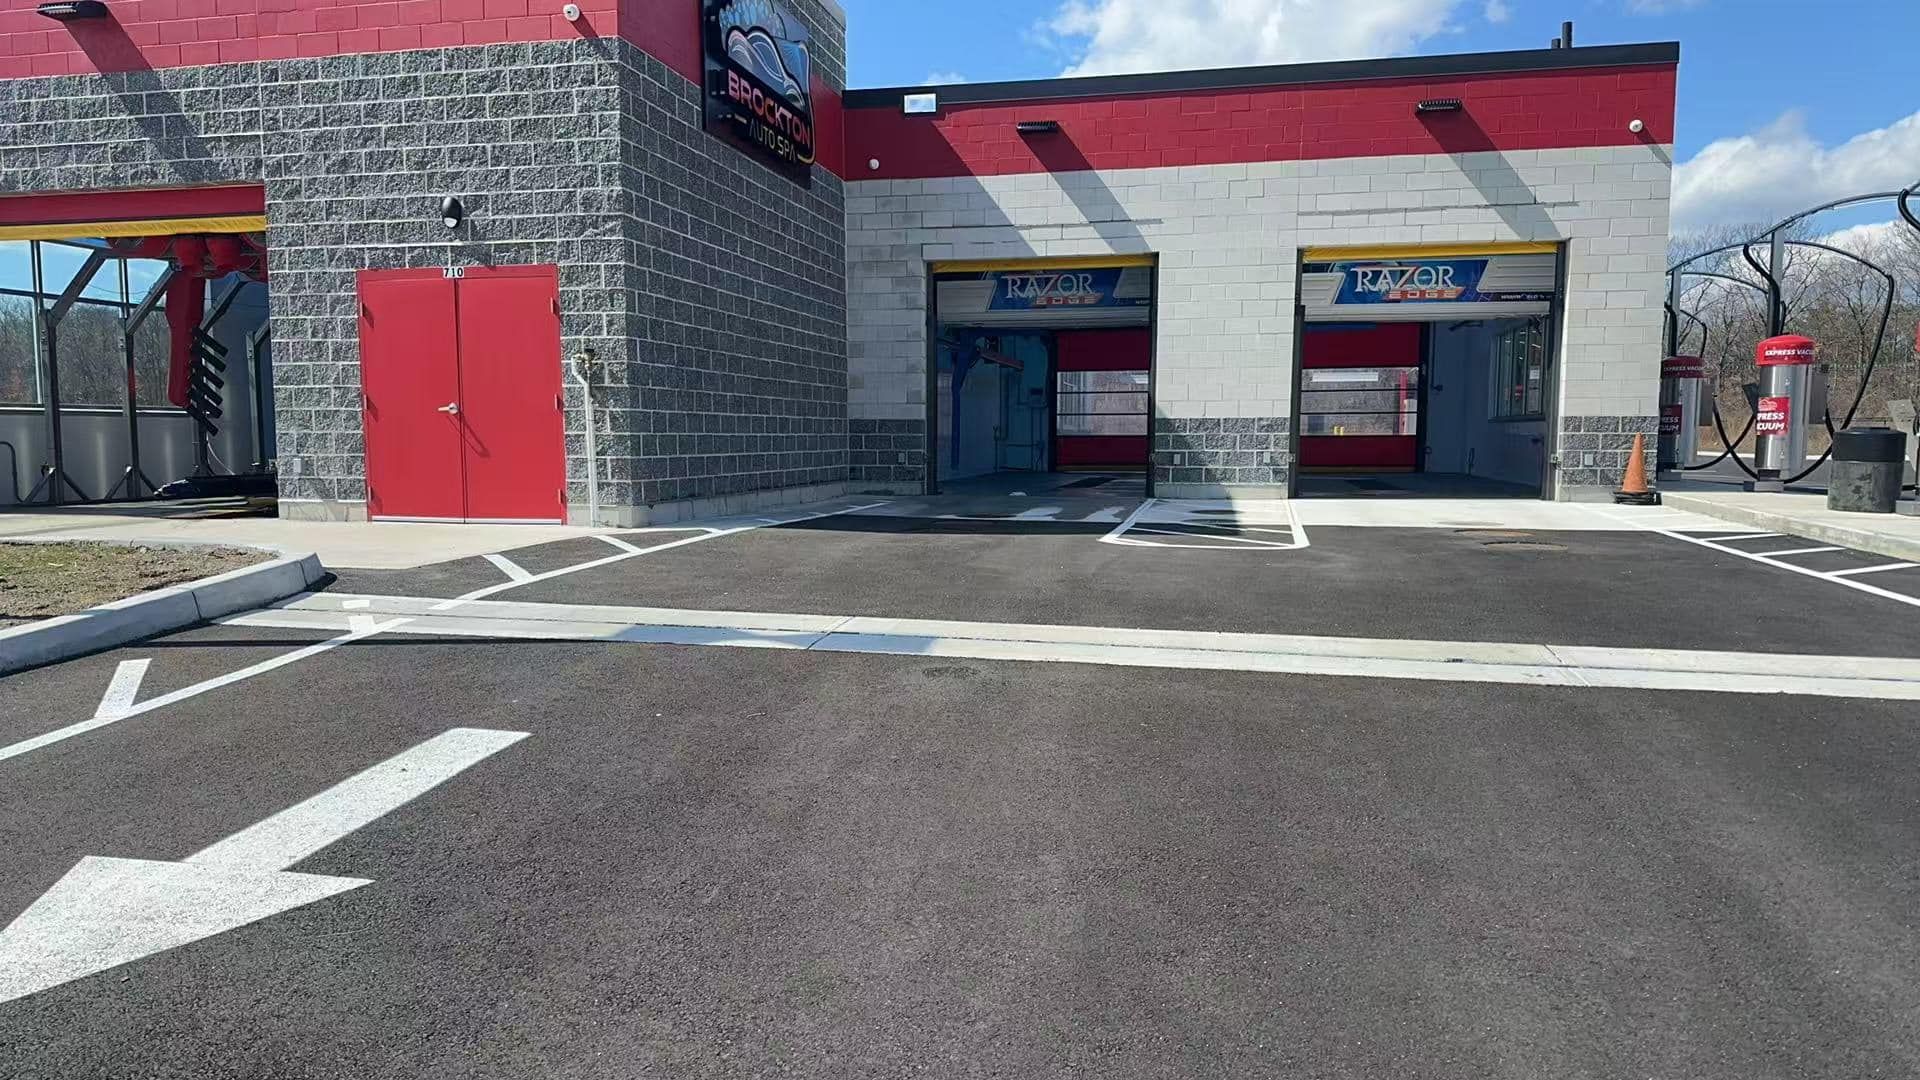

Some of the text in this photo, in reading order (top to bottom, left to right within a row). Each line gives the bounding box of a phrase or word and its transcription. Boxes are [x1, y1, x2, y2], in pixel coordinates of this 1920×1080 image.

[728, 69, 810, 148] BROCKTON
[749, 119, 796, 161] AUTO SPA
[444, 267, 463, 277] 710
[1349, 265, 1457, 292] RAZOR
[1001, 273, 1096, 299] RAZOR
